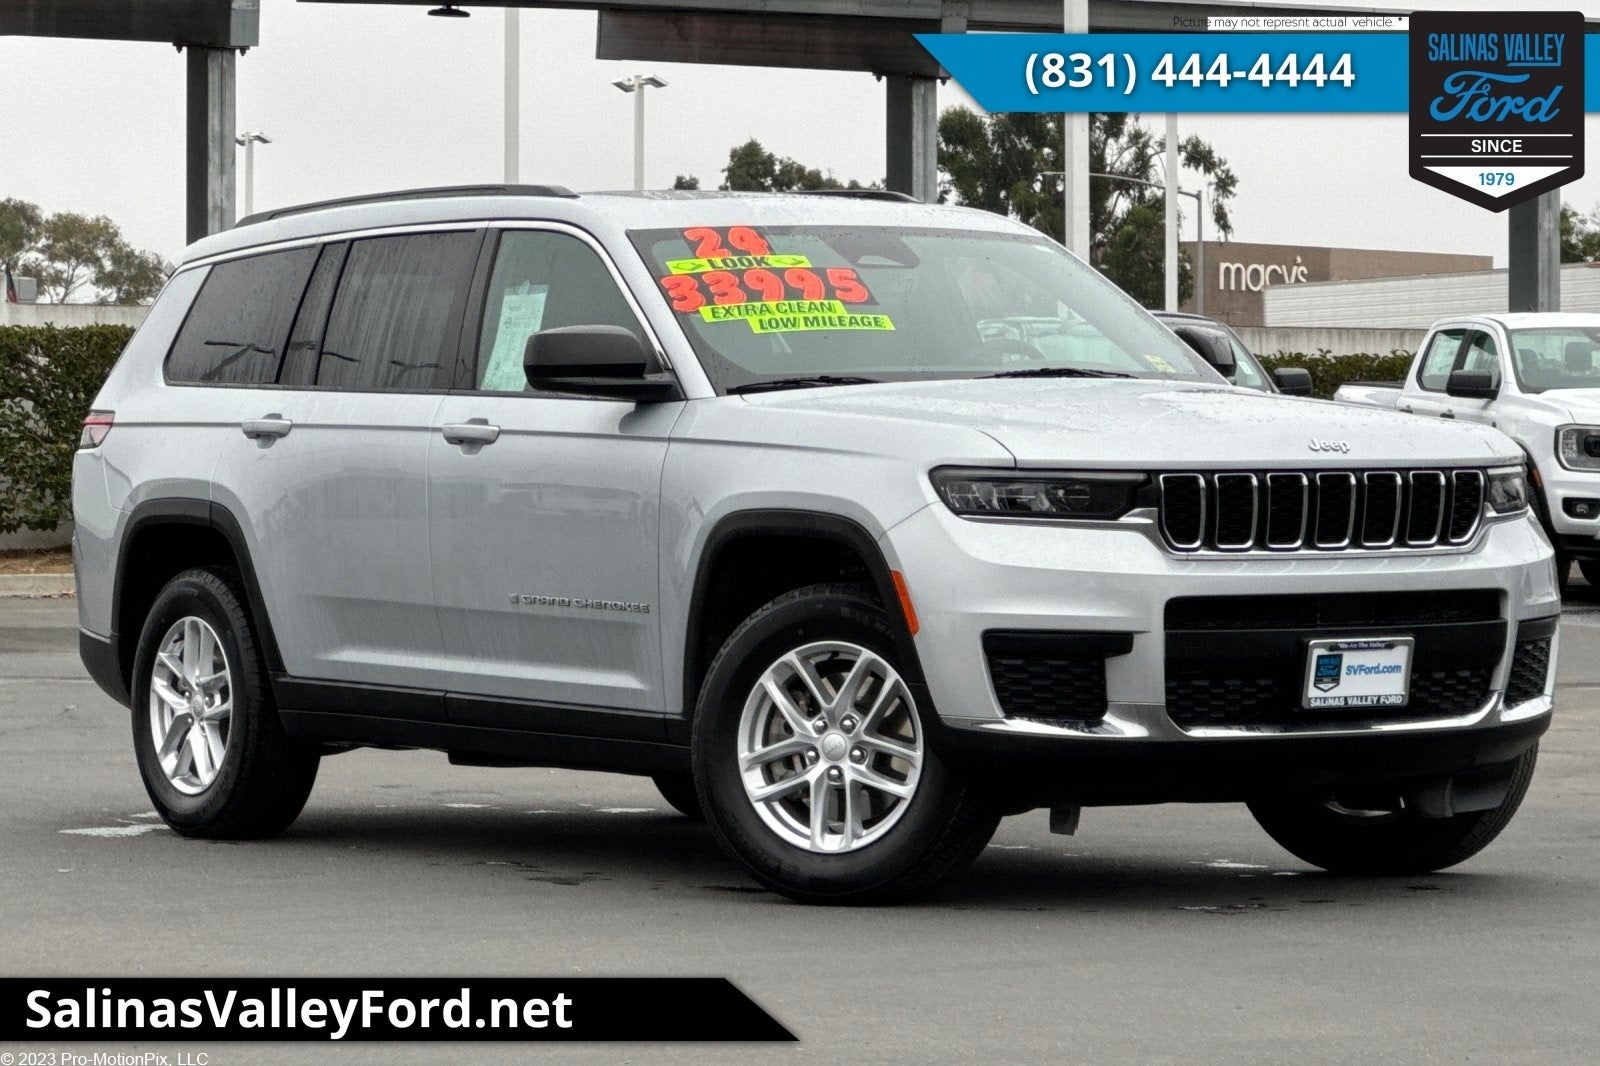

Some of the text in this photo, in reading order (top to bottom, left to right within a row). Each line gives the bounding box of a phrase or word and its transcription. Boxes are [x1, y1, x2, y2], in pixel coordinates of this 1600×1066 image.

[706, 256, 771, 270] LOOK
[660, 267, 869, 313] 33995
[710, 301, 837, 319] EXTRA CLEAN
[758, 314, 887, 331] LOW MILEAGE
[1308, 438, 1351, 454] Jeep
[520, 594, 651, 613] GRAND CHEROKEE
[1345, 663, 1402, 676] SVFord.com
[1310, 695, 1402, 707] SALINAS VALLEY FORD
